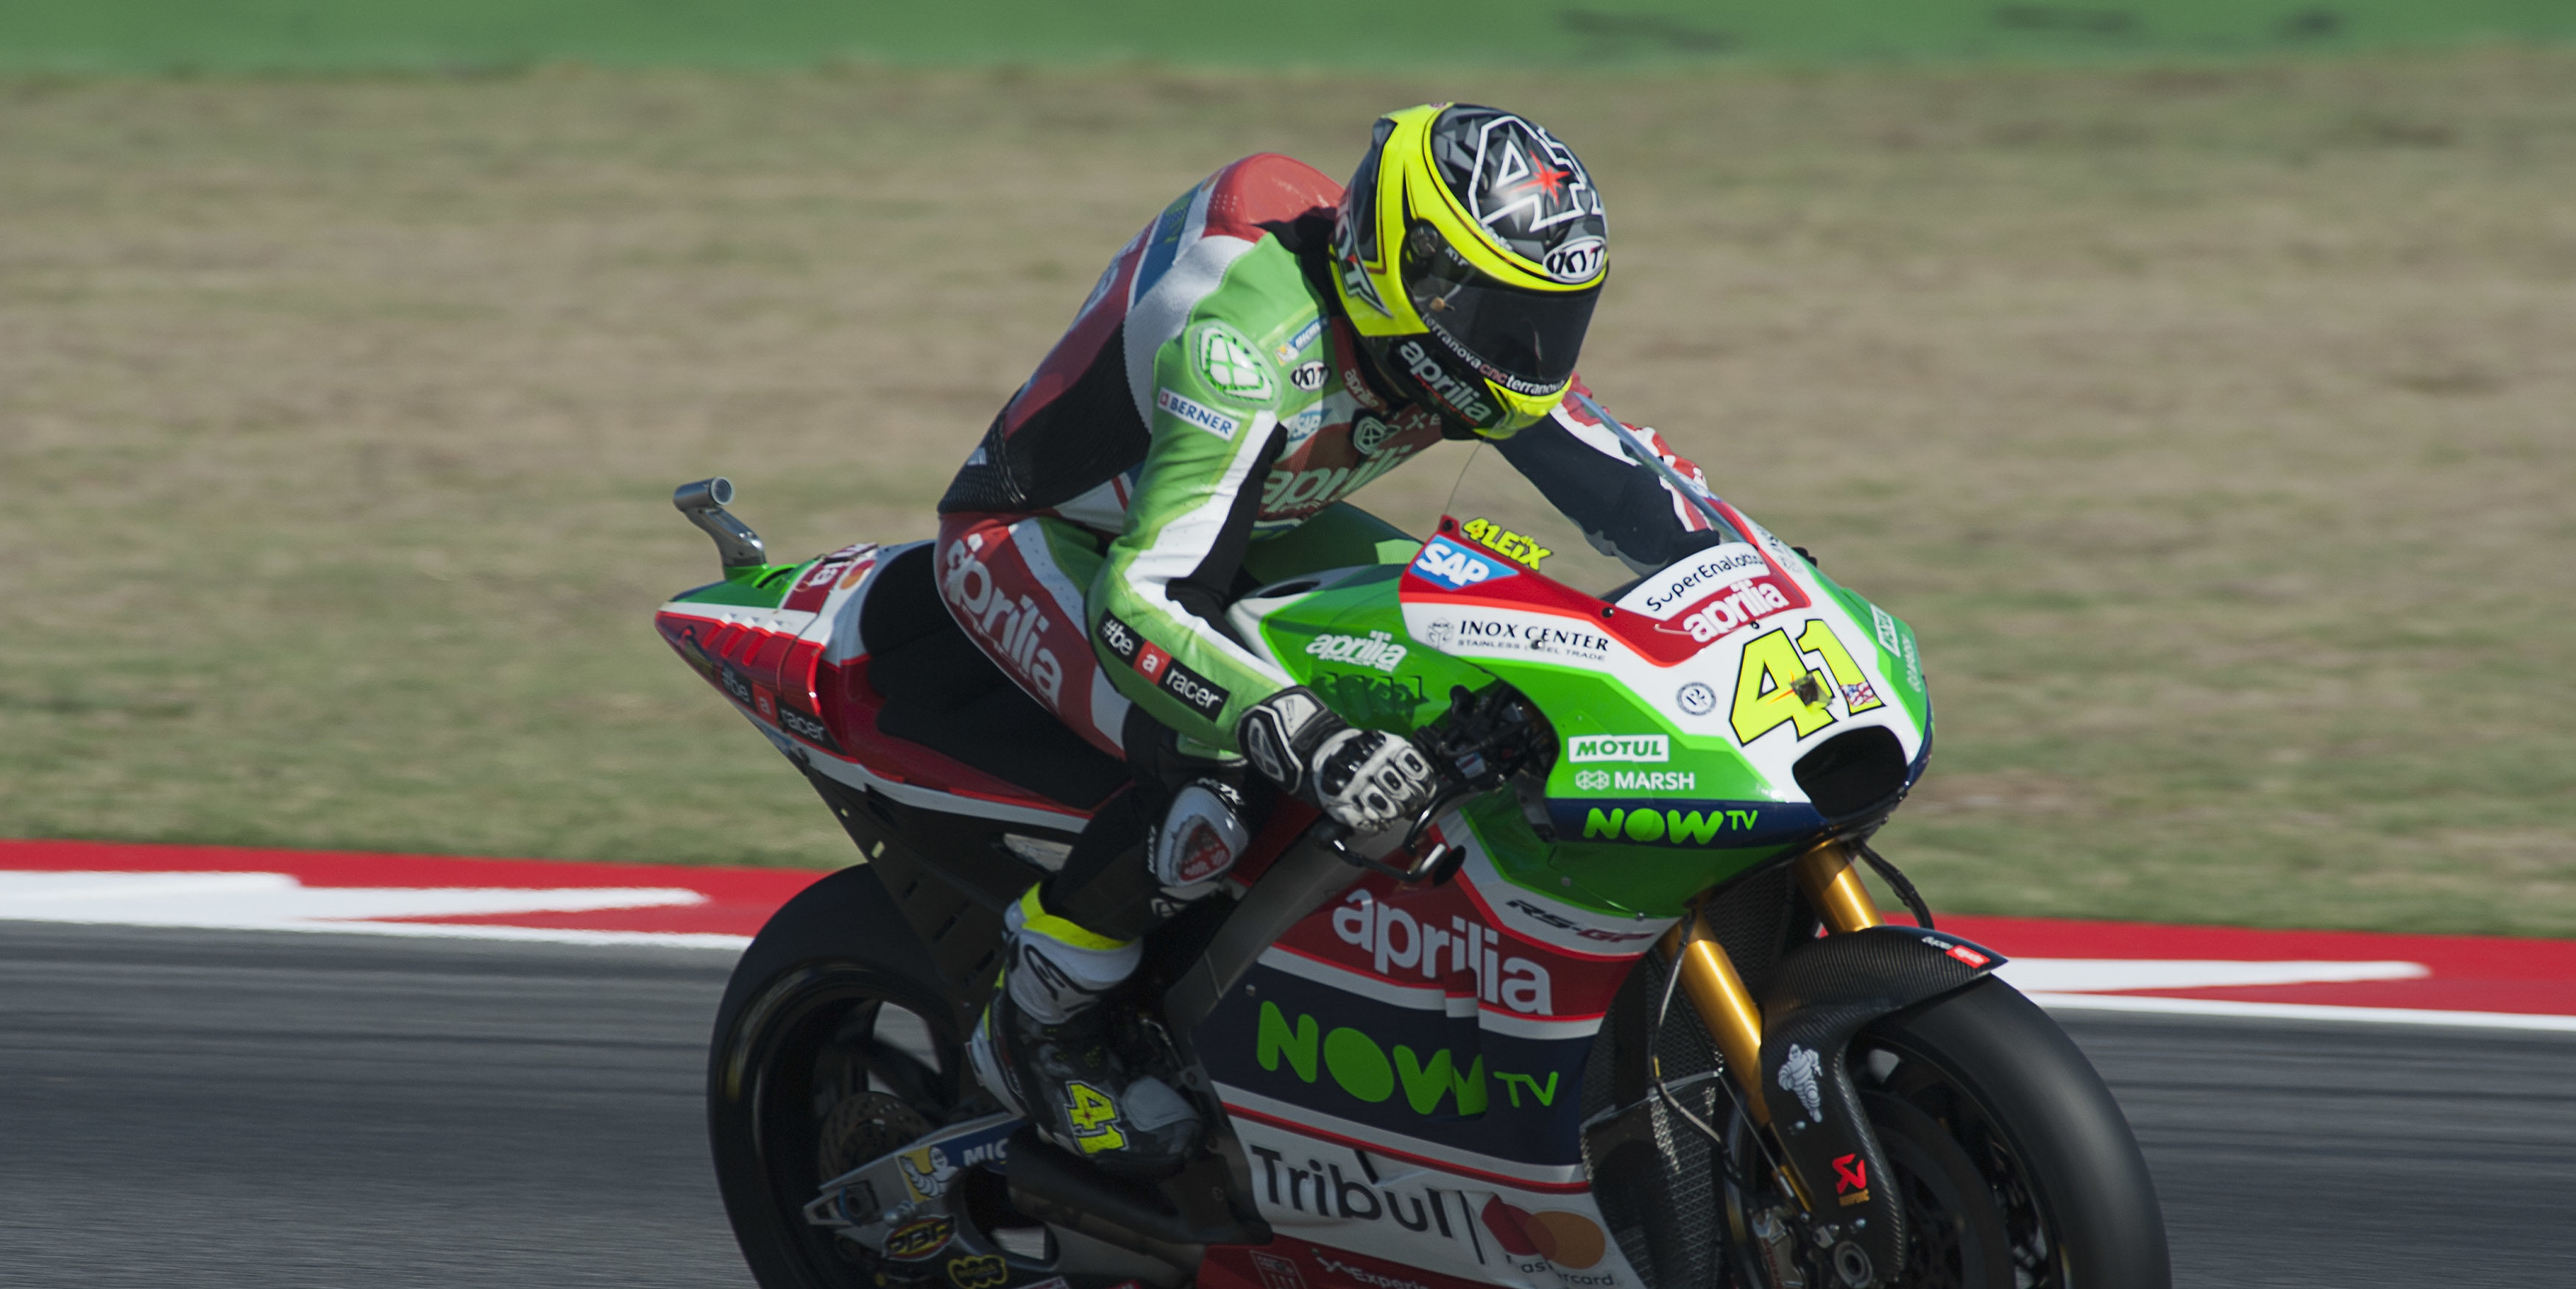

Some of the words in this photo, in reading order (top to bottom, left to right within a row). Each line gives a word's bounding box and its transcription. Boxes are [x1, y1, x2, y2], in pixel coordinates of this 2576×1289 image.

[1400, 341, 1492, 422] aprilia
[1169, 397, 1234, 436] BERNER
[1415, 543, 1490, 586] SAP
[1682, 578, 1790, 643] aprilia
[1306, 631, 1407, 672] aprilia
[1457, 639, 1521, 650] STAINLESS
[1565, 650, 1605, 661] TRADE
[1460, 620, 1518, 638] INOX
[1525, 626, 1609, 652] CENTER
[1142, 653, 1159, 673] a
[1166, 668, 1218, 710] racer
[1730, 619, 1886, 746] 41
[779, 706, 825, 742] racer
[1576, 739, 1662, 756] MOTUL
[1614, 772, 1695, 789] MARSH
[1584, 807, 1724, 845] NOW
[1727, 810, 1758, 830] TV
[1332, 889, 1554, 1015] aprilia
[1257, 1001, 1489, 1116] NOW
[1494, 1071, 1559, 1107] TV
[1064, 1080, 1128, 1155] 41
